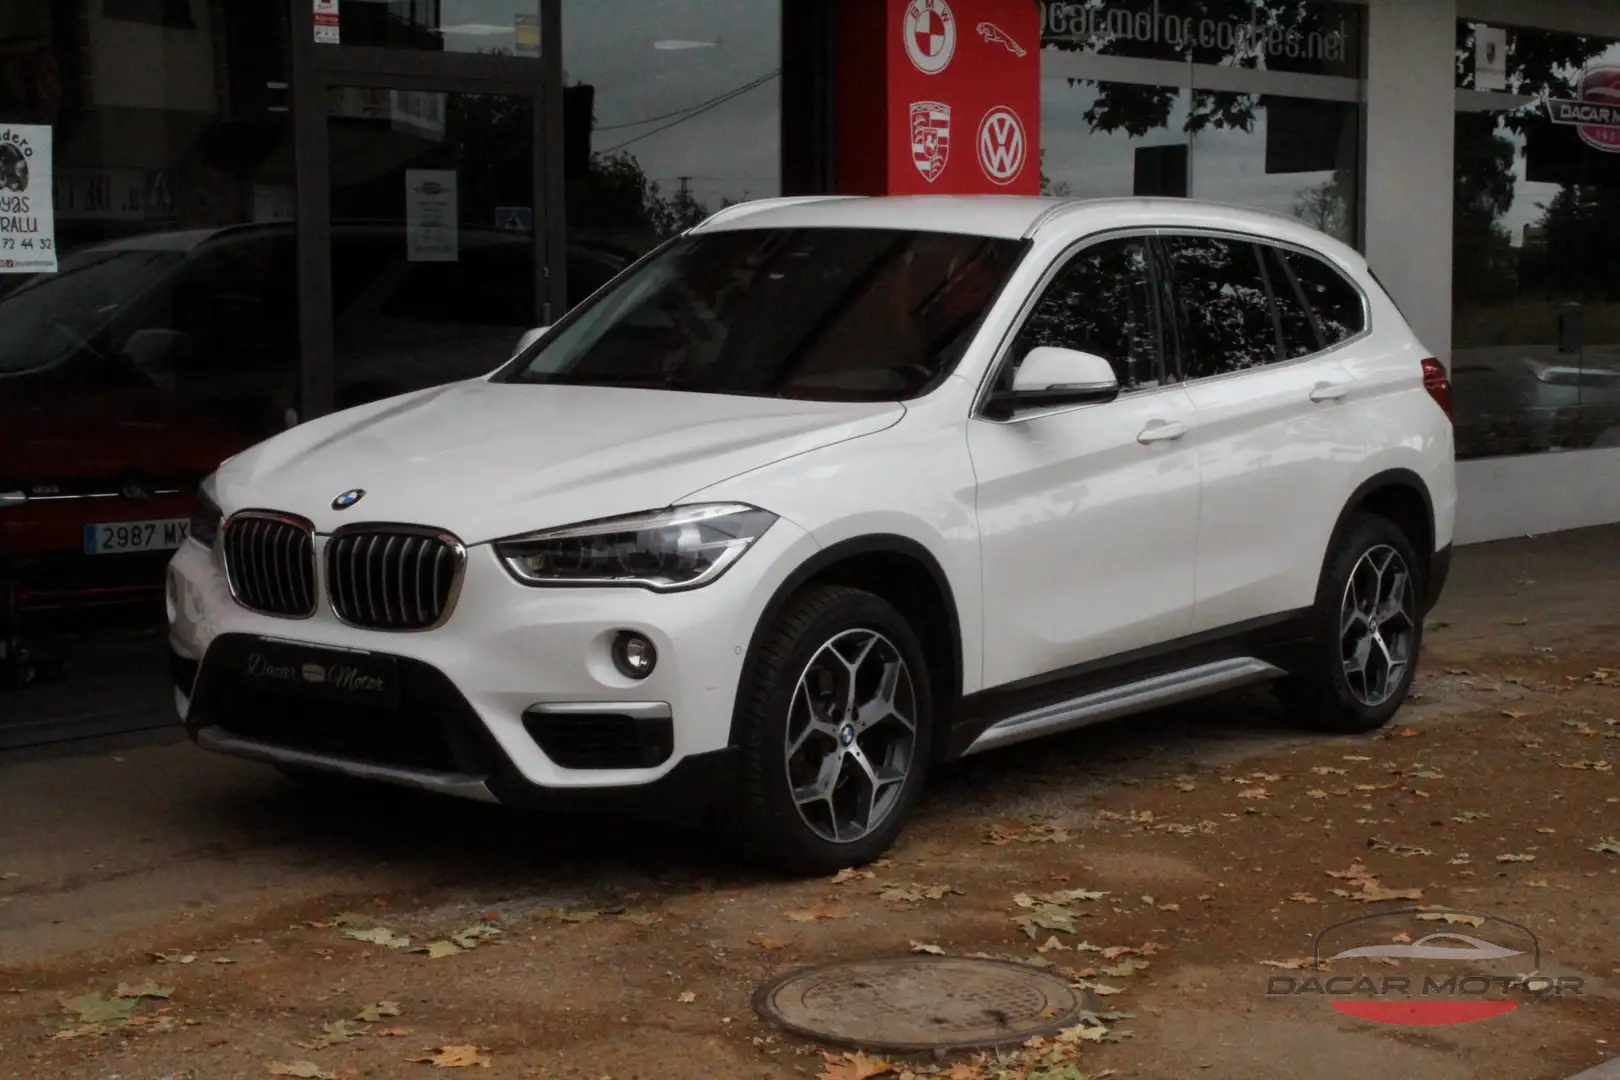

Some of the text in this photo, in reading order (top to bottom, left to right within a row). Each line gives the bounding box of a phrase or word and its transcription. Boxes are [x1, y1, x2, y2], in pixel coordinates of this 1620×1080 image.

[910, 0, 950, 22] BMW
[1559, 104, 1610, 123] DACAR
[0, 196, 30, 214] yas
[0, 216, 38, 233] RALU
[2, 238, 52, 250] 72 44 32
[103, 522, 188, 549] 2987 MX
